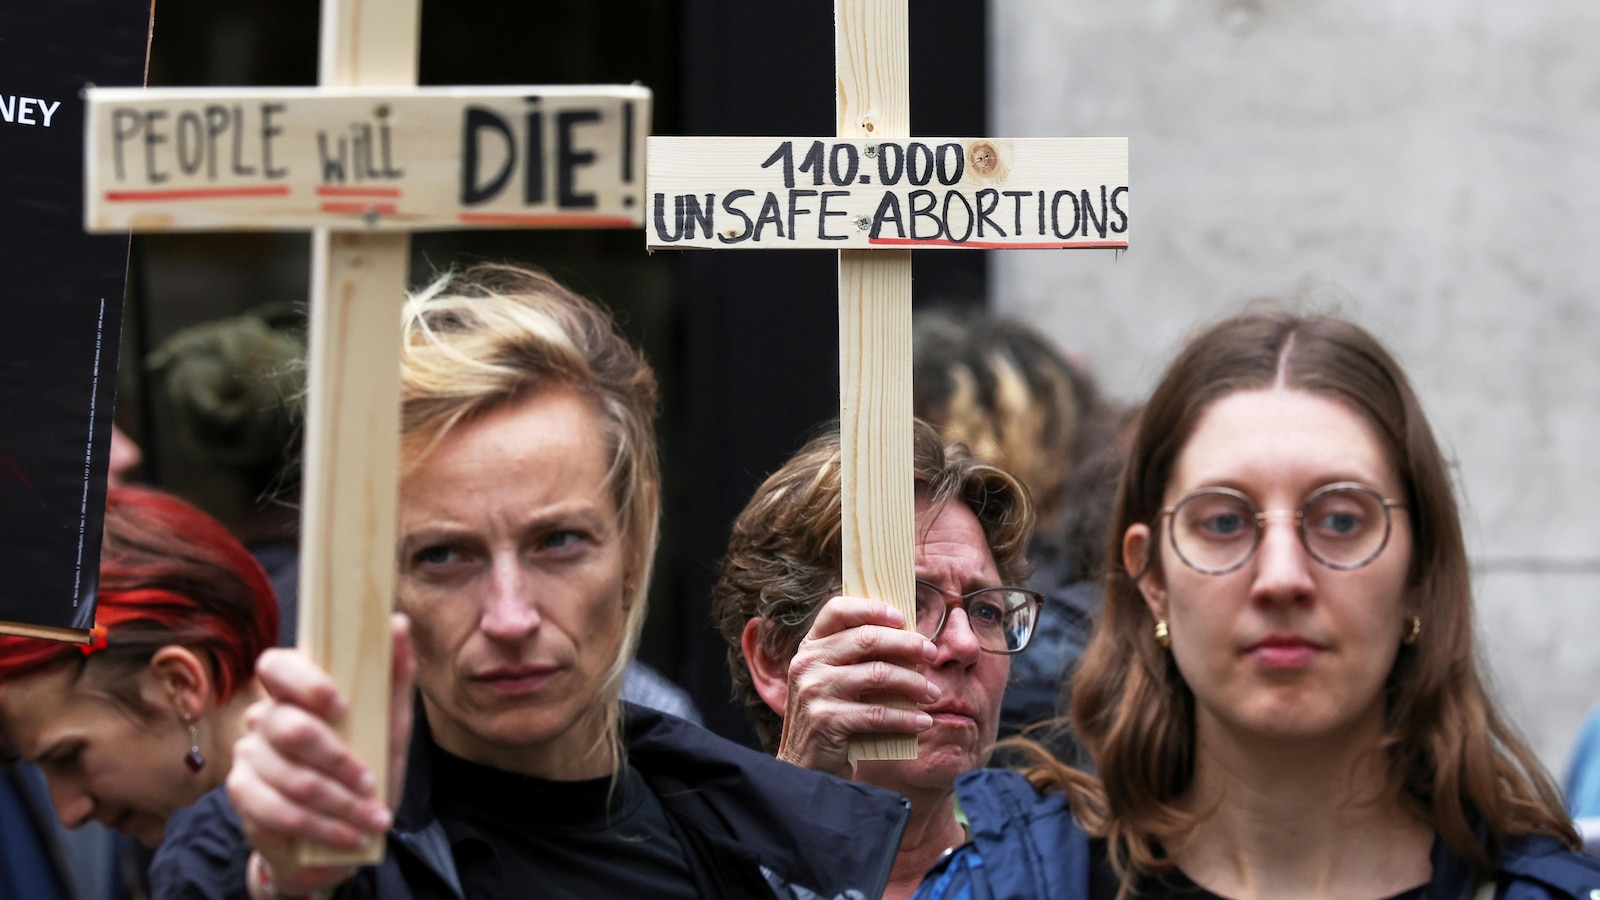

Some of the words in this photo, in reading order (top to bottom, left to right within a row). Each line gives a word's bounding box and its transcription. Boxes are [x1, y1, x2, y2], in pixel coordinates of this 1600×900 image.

[110, 103, 288, 184] PEOPLE
[761, 140, 965, 188] 110.000
[653, 188, 851, 243] UNSAFE
[868, 184, 1129, 243] ABORTIONS
